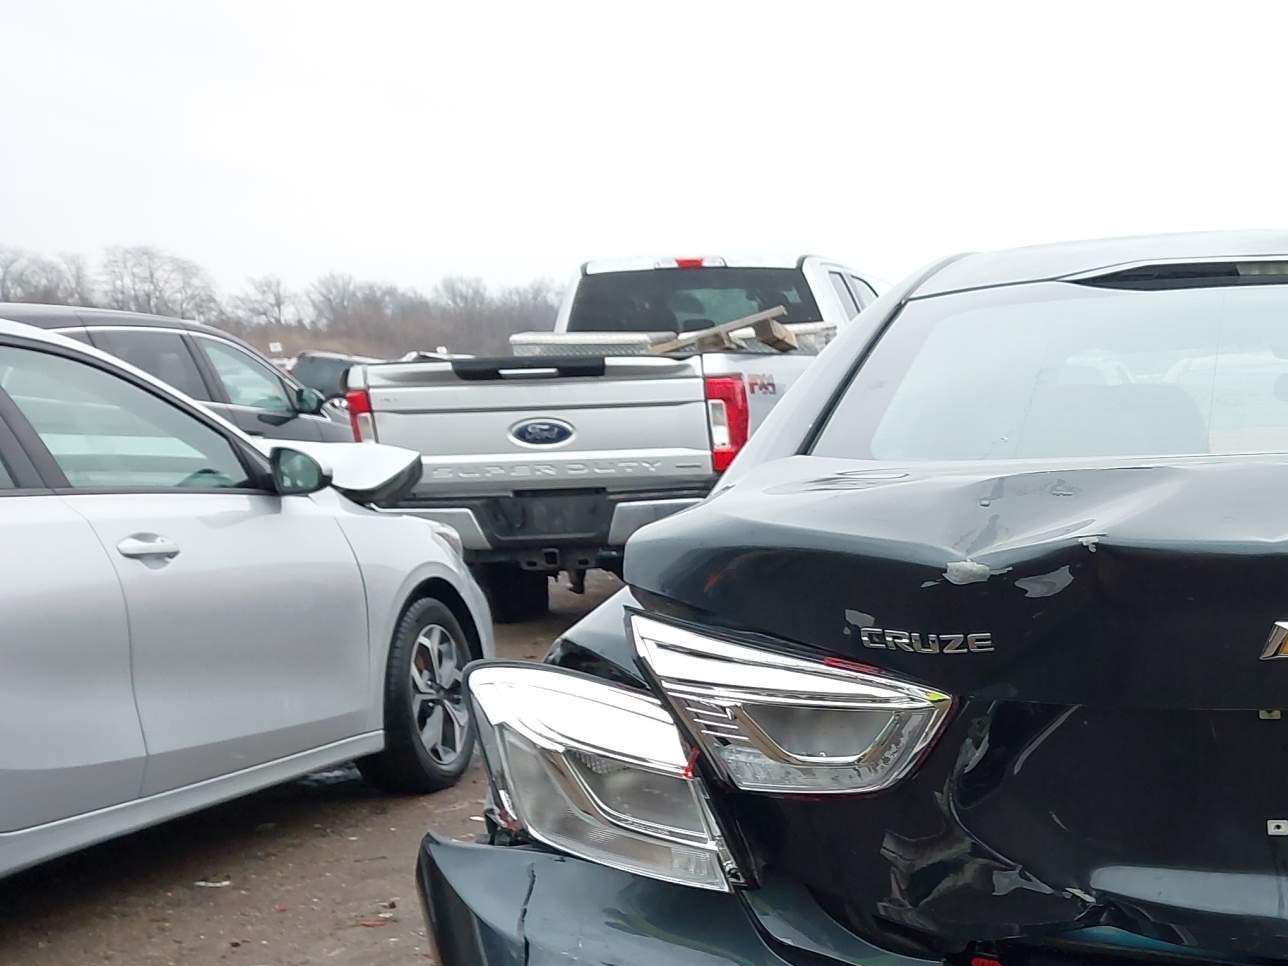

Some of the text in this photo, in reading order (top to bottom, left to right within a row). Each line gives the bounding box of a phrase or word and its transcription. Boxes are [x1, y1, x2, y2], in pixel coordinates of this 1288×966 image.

[431, 463, 558, 480] SUPER
[567, 460, 662, 475] DUTY
[860, 627, 995, 654] CRUZE
